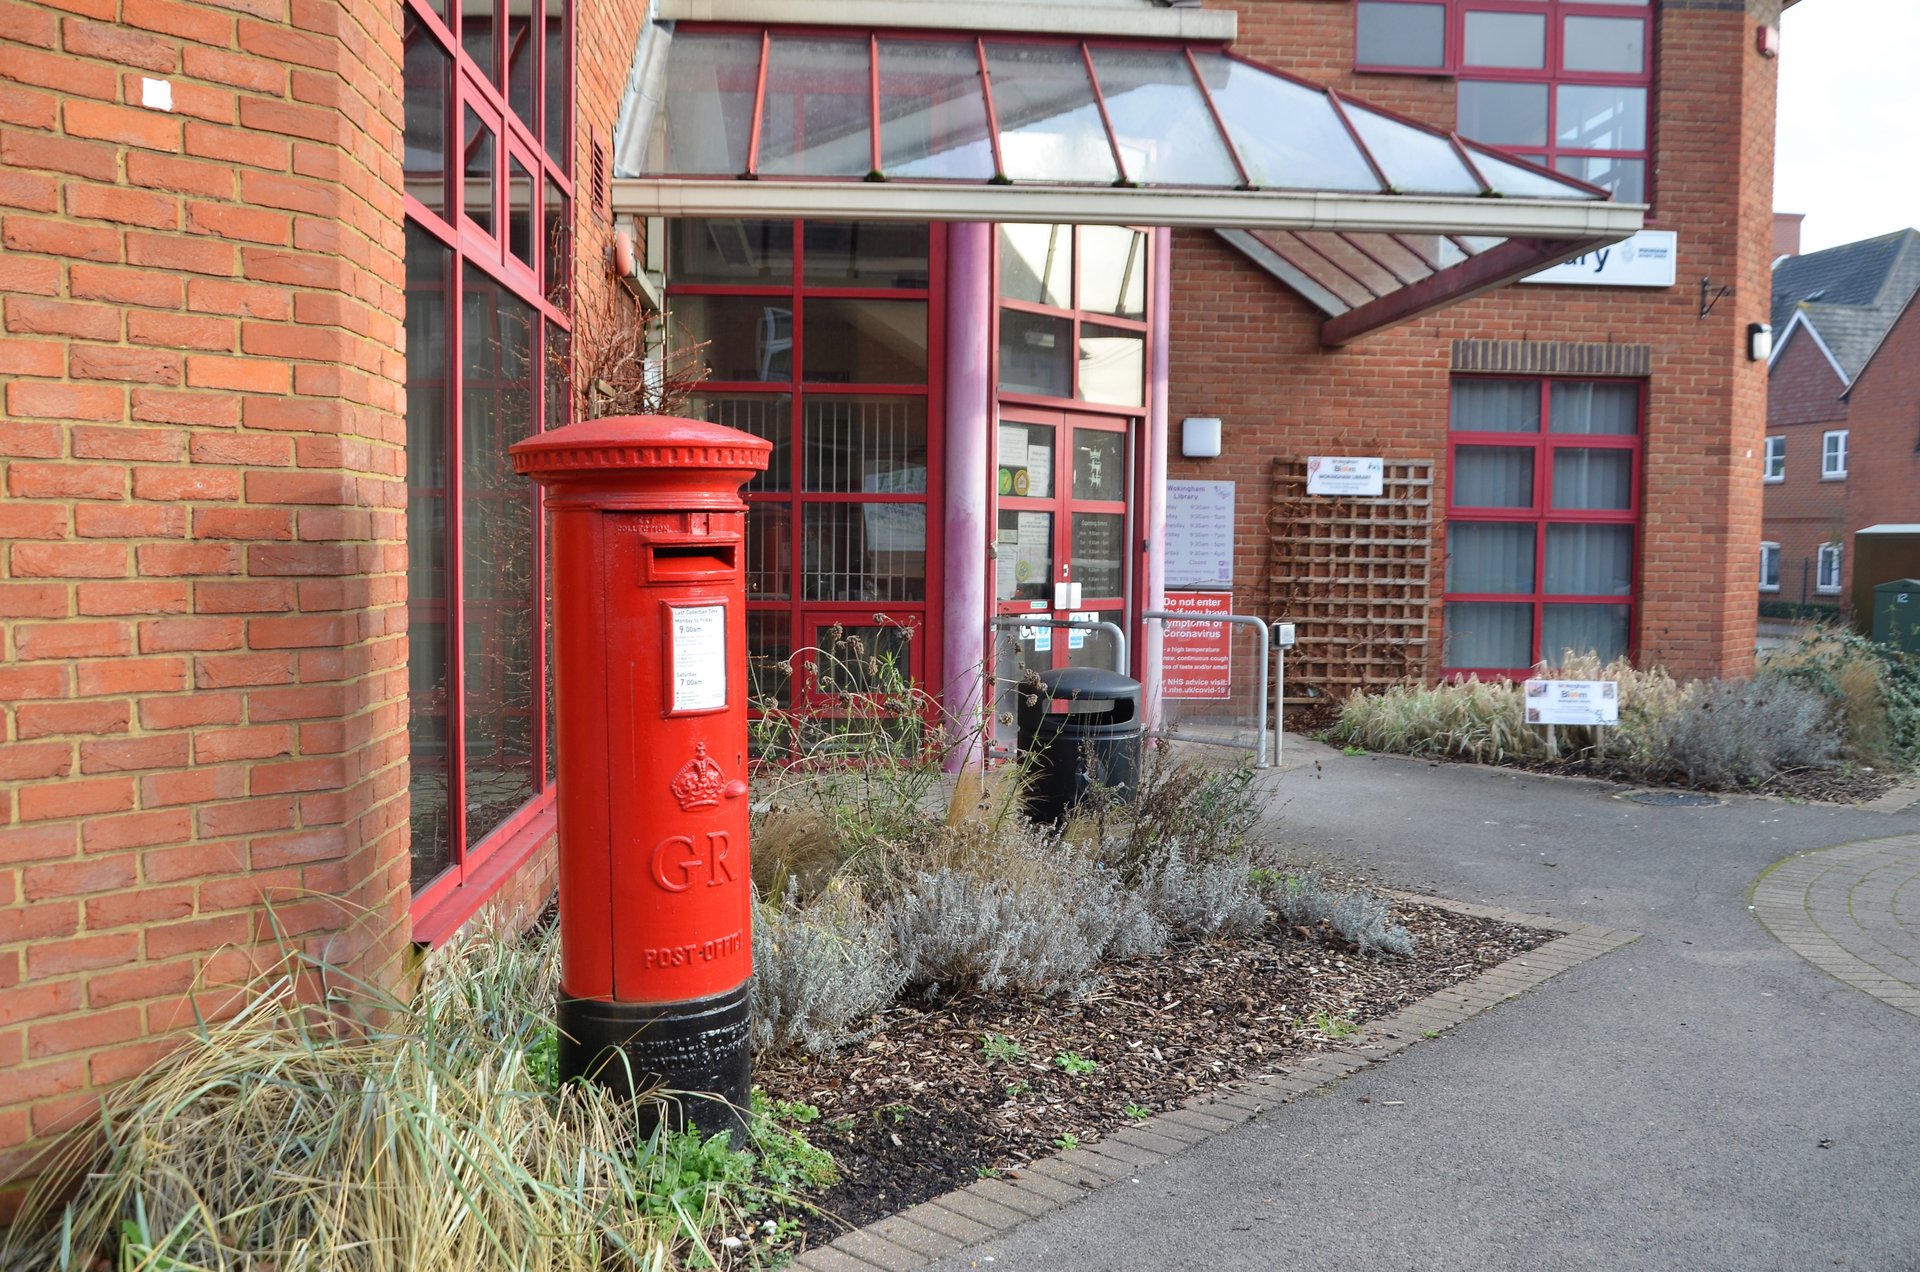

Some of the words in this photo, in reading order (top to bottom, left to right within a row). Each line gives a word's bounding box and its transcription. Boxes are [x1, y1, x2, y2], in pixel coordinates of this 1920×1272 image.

[1164, 597, 1177, 606] Do
[1197, 598, 1222, 606] enter
[679, 625, 702, 633] 9.00am
[1166, 620, 1211, 629] ymptoms
[1163, 629, 1221, 638] Coronavirus
[1172, 645, 1184, 653] high
[644, 944, 697, 969] POST
